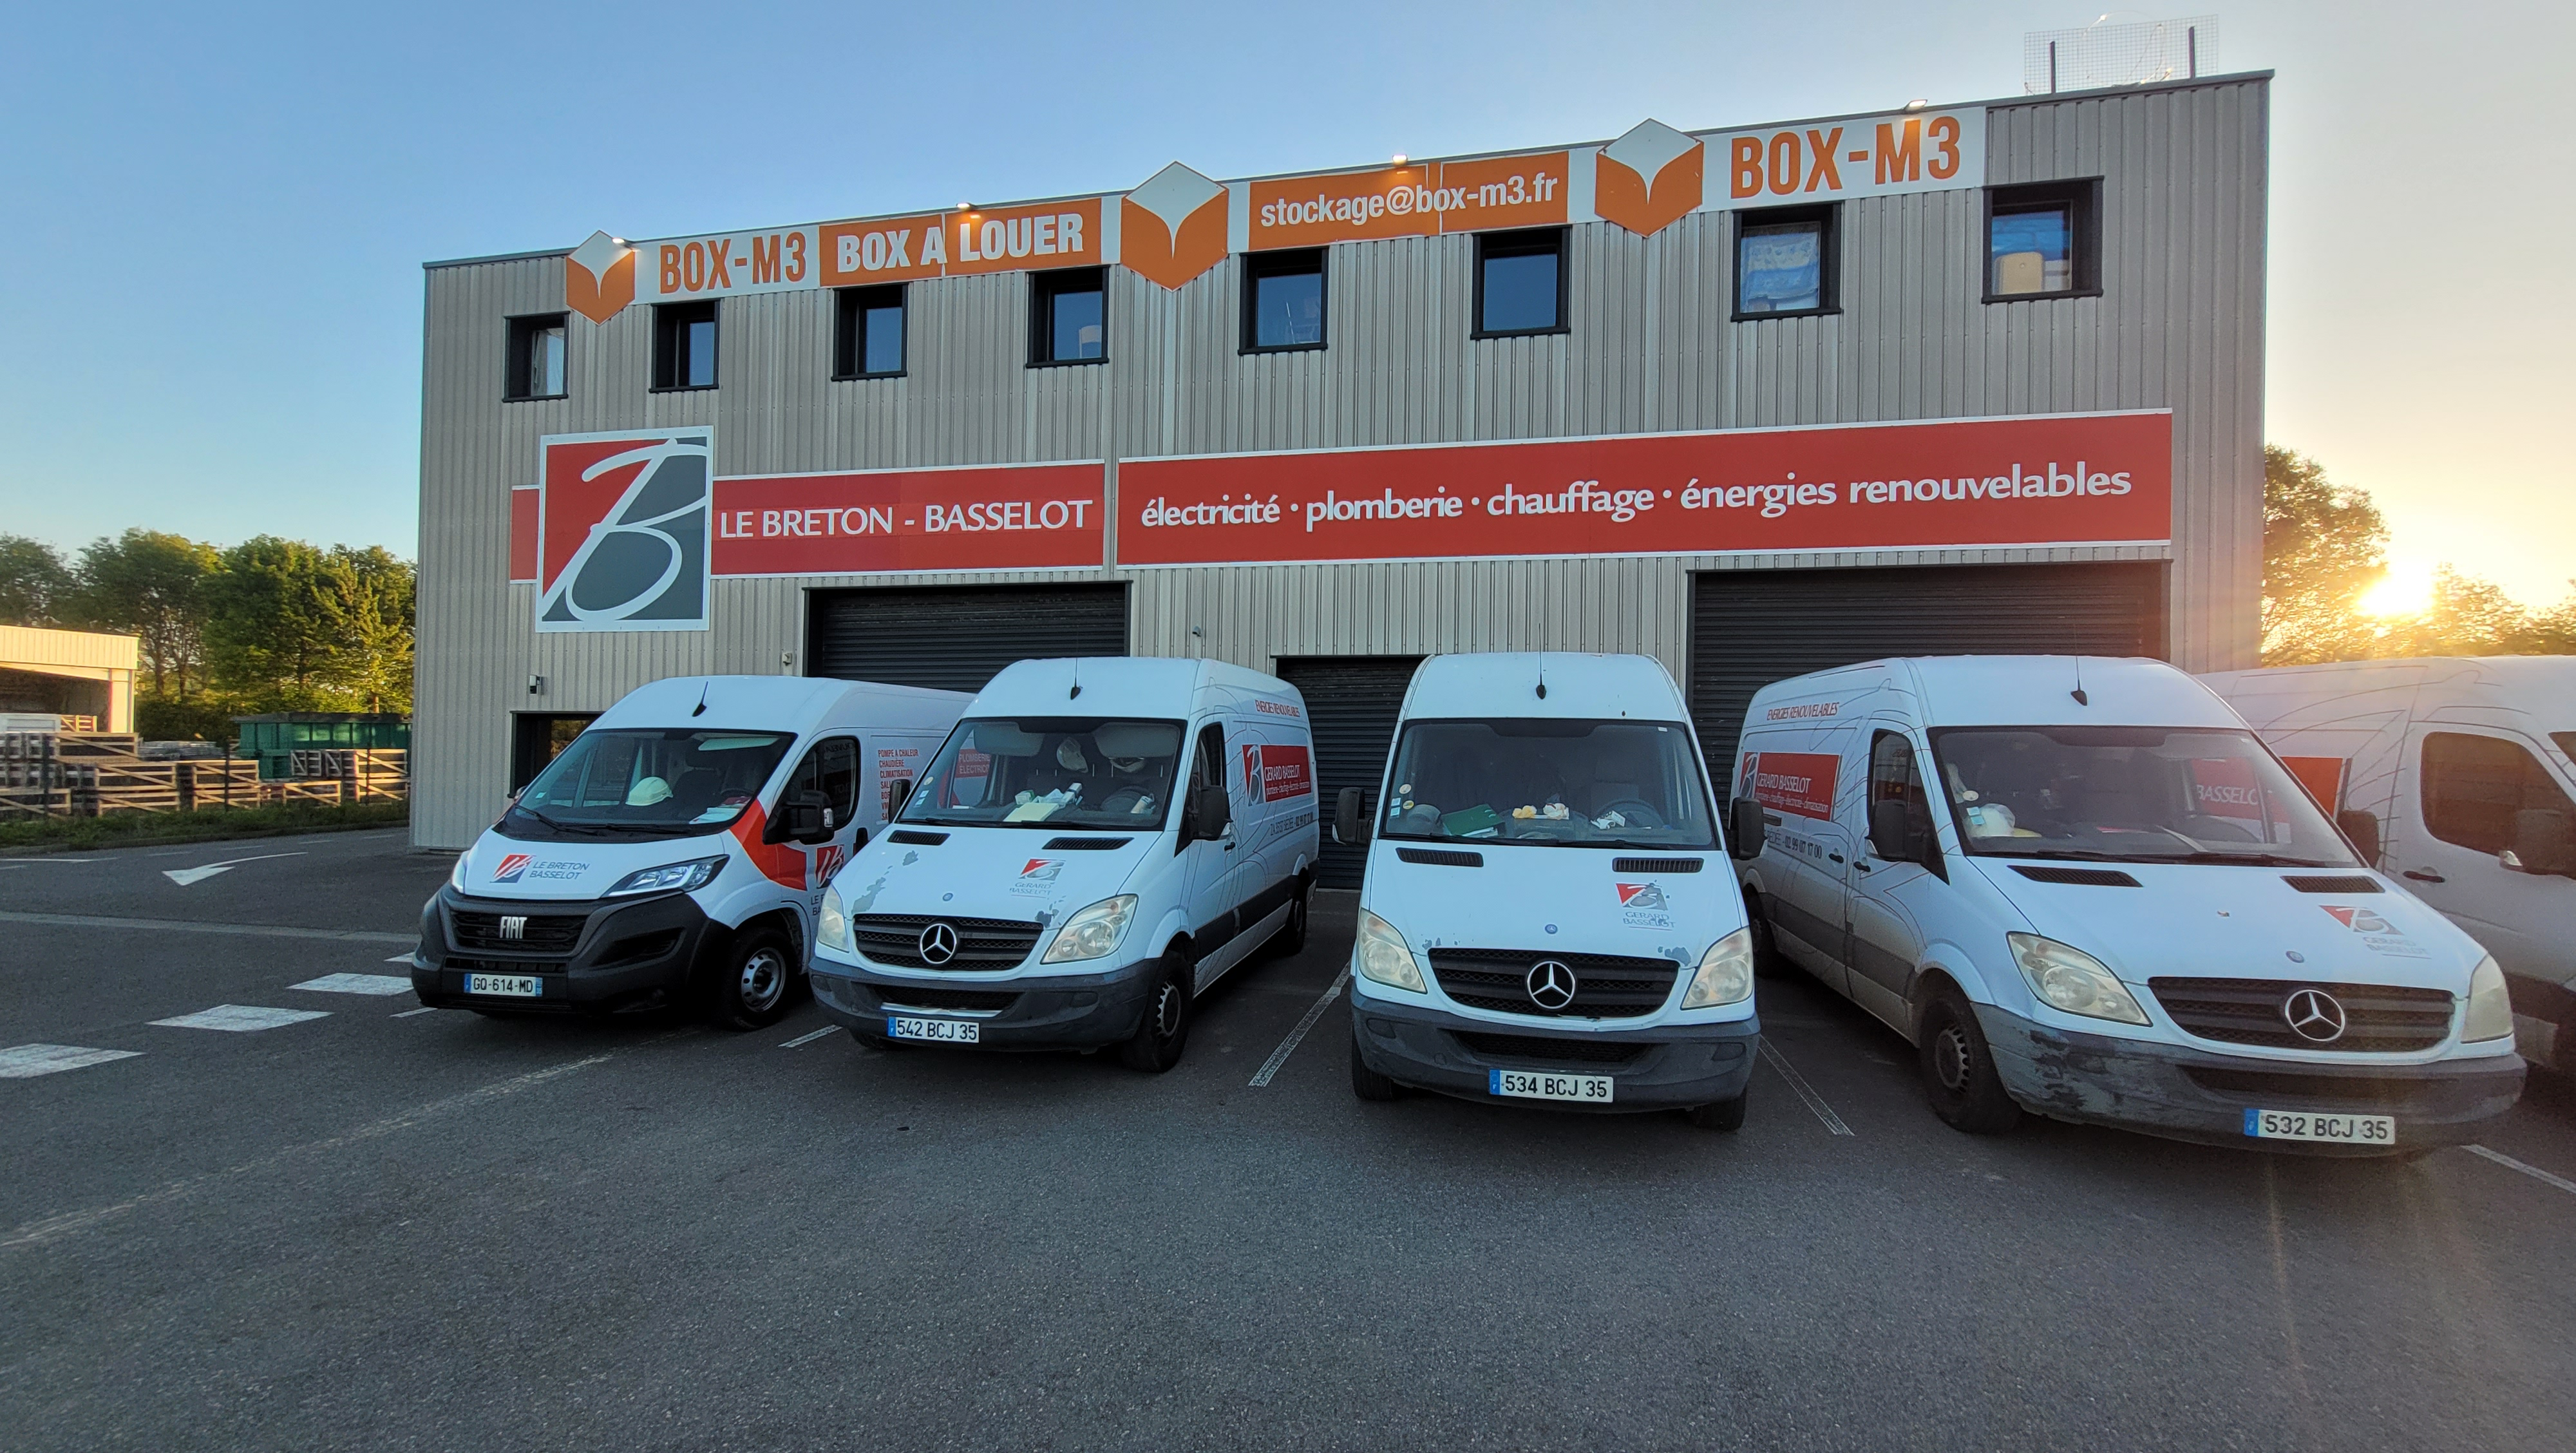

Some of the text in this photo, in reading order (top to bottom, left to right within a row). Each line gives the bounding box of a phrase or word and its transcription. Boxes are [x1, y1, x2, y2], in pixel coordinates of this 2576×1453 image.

[1731, 116, 1960, 198] BOX-M3
[1260, 172, 1558, 227] stockage@box-m3.fr
[837, 213, 1084, 273] BOX A LOUER
[659, 232, 805, 294] BOX-M3
[1141, 493, 1280, 527] électricité
[1306, 486, 1463, 532] plomberie
[1487, 479, 1654, 522] chauffage
[1680, 472, 1837, 518] énergies
[1850, 461, 2132, 504] renouvelables
[721, 511, 753, 538] LE
[762, 506, 893, 537] BRETON
[925, 499, 1093, 532] BASSELOT
[878, 750, 894, 758] POMPE
[899, 748, 919, 757] CHALEUR
[880, 769, 913, 779] CLIMATISATION
[1264, 764, 1300, 782] GERARD BASSELOT
[1757, 773, 1812, 794] GERARD BASSELOT
[2196, 784, 2259, 805] BASSELO
[529, 871, 582, 880] BASSELOT
[547, 862, 591, 870] BRETON
[1625, 911, 1669, 920] GERARD
[500, 916, 527, 939] FIAT
[473, 978, 533, 993] GQ-614-MD
[897, 1020, 923, 1037] 542
[927, 1022, 954, 1039] BCJ
[960, 1024, 977, 1040] 35
[1505, 1075, 1538, 1094] 534
[1545, 1078, 1578, 1096] BCJ
[1586, 1080, 1607, 1097] 35
[2264, 1114, 2306, 1135] 532
[2314, 1118, 2354, 1137] BCJ
[2362, 1120, 2387, 1140] 35
